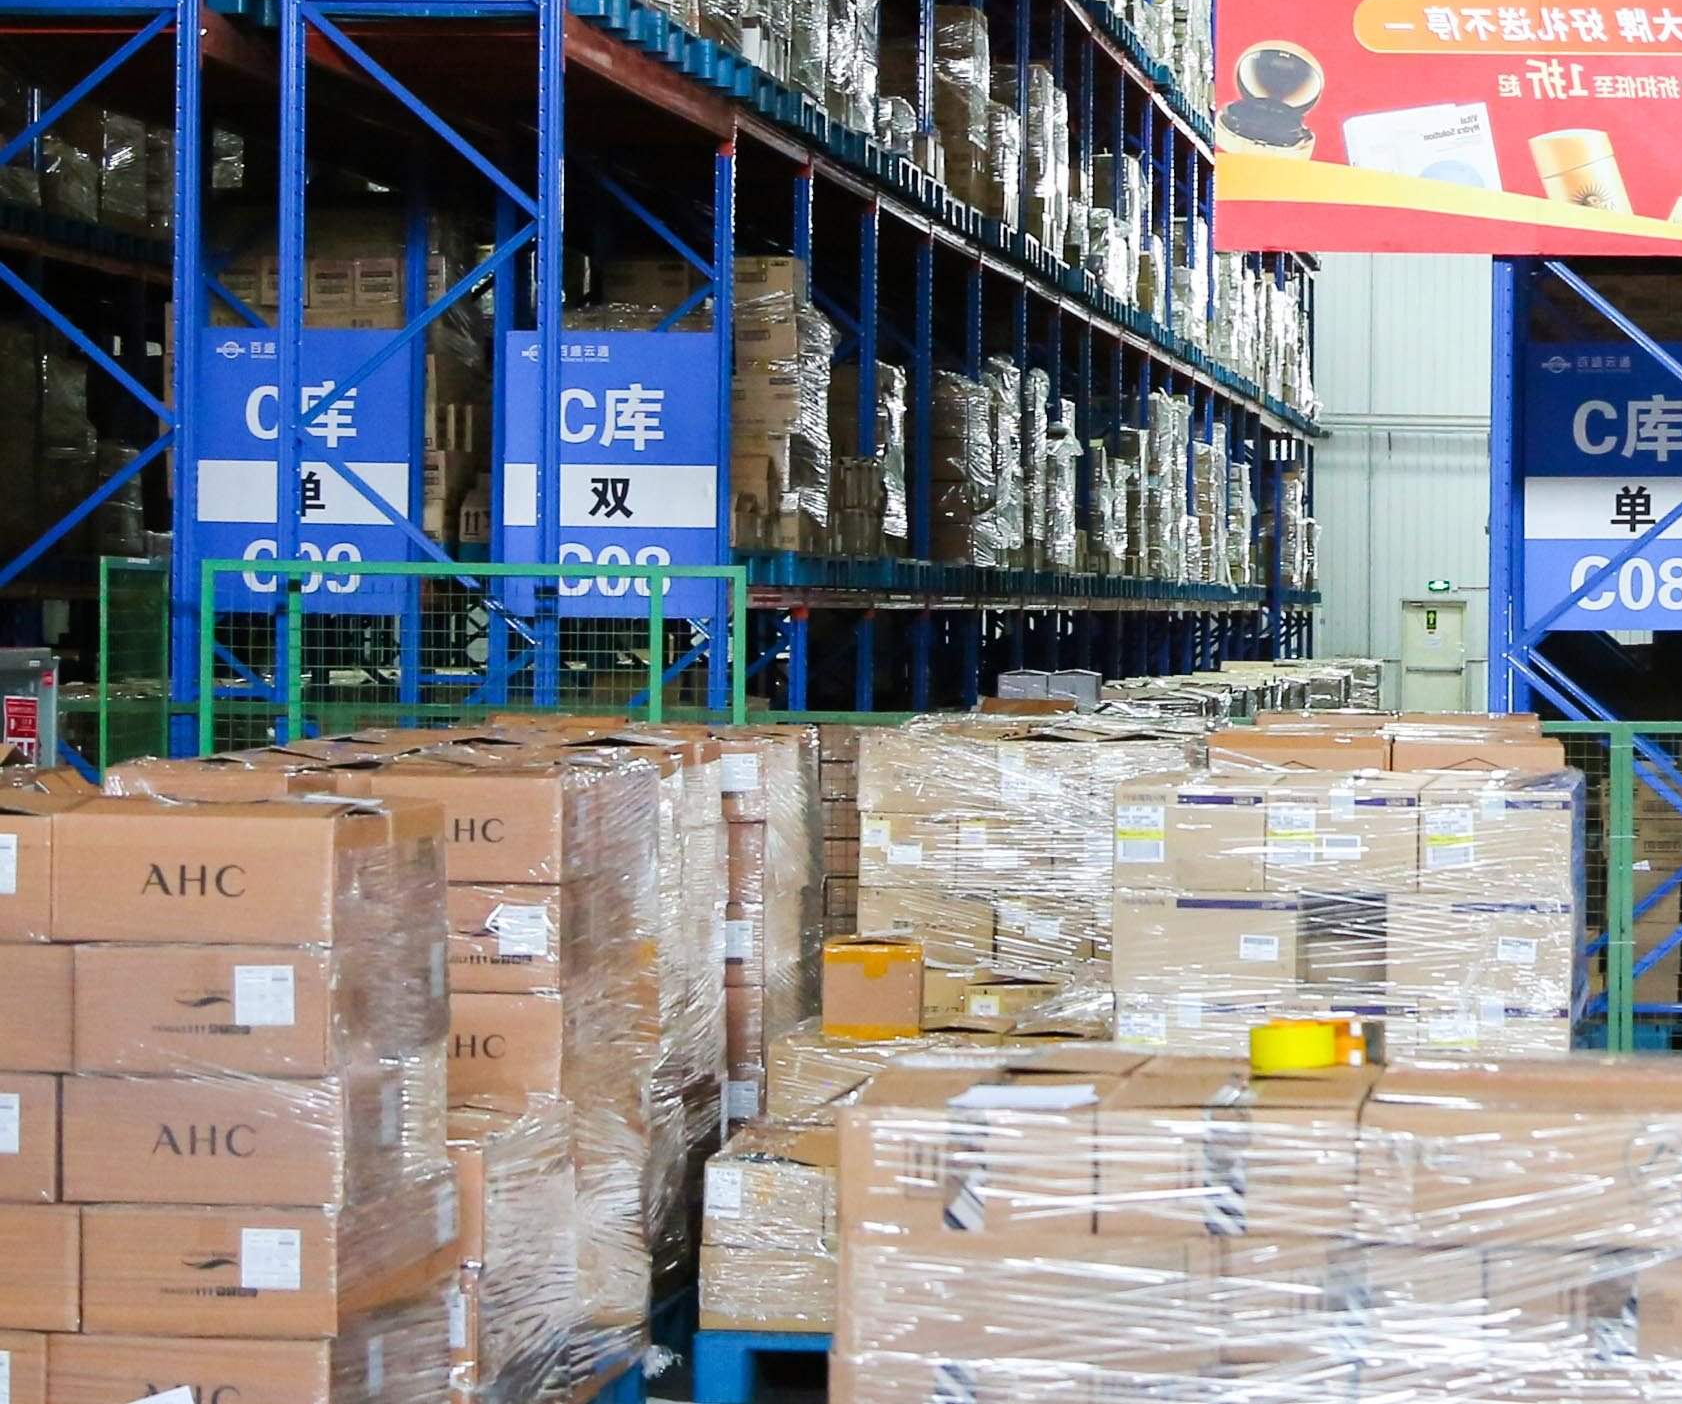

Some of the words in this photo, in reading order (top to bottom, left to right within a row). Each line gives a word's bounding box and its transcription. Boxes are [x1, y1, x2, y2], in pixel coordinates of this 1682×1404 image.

[250, 342, 276, 354] 百盛
[560, 383, 664, 451] C库
[588, 478, 633, 518] 双
[1610, 486, 1656, 532] 单
[558, 543, 670, 596] C08
[446, 818, 504, 844] HC
[141, 864, 246, 898] AHC
[448, 1032, 506, 1060] HC
[152, 1124, 256, 1158] AHC
